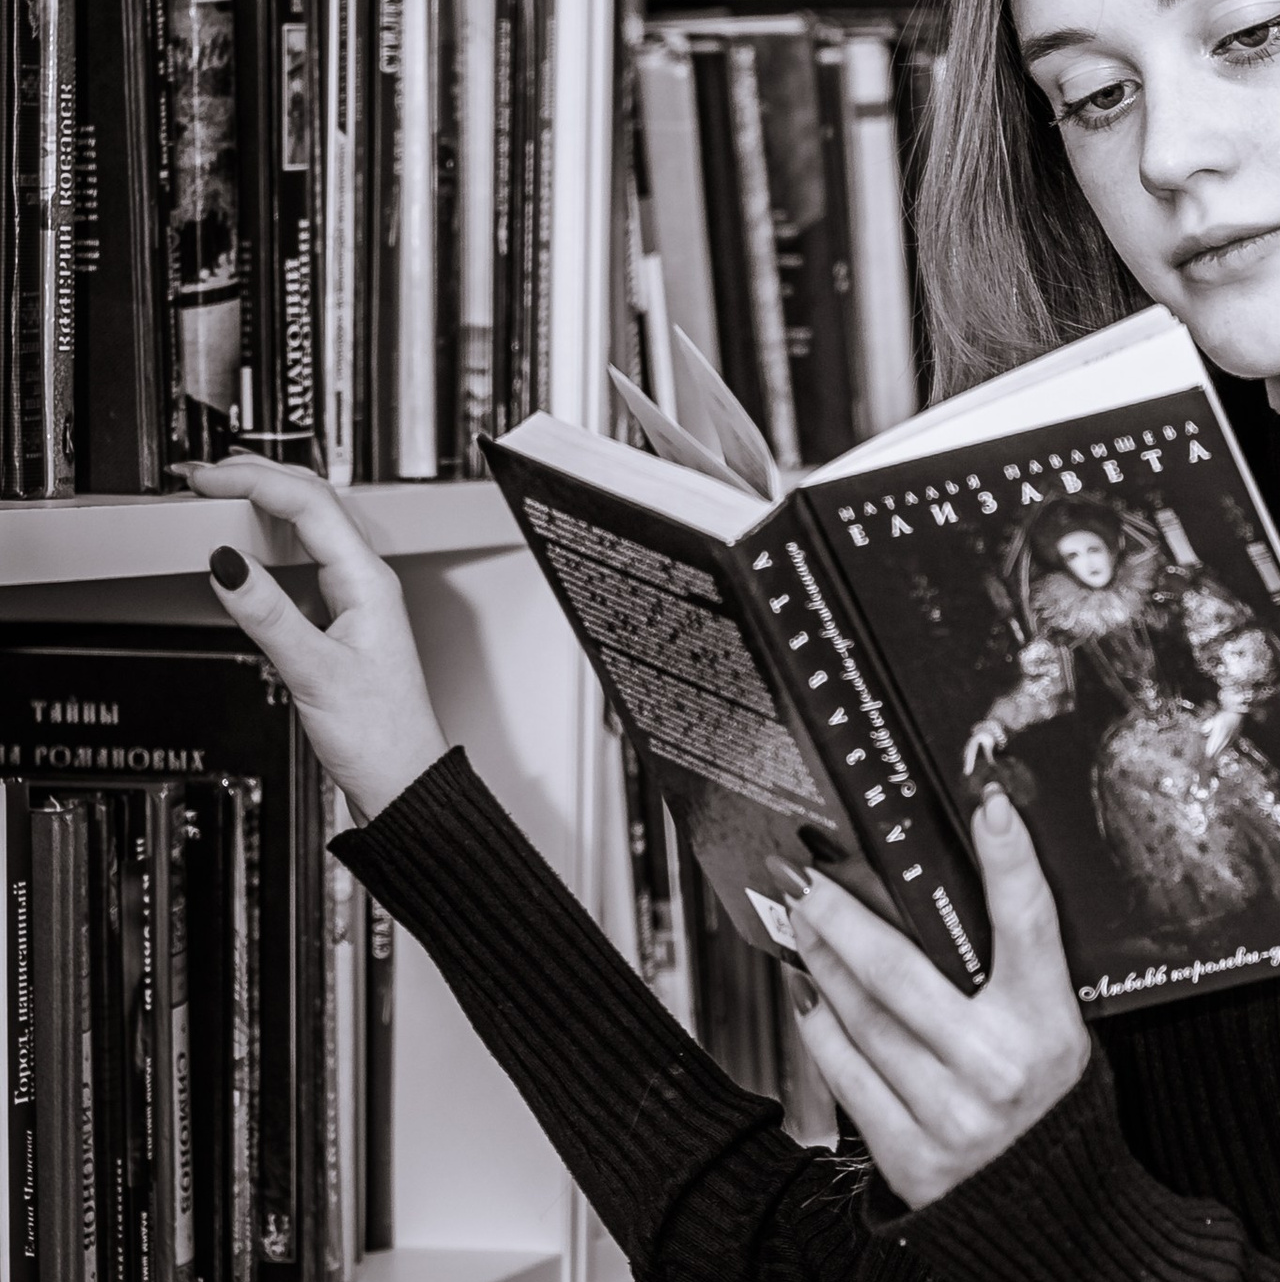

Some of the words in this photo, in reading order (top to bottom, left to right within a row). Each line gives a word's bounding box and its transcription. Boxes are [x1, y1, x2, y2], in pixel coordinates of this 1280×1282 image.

[285, 258, 304, 426] АНАТОЛИЙ
[838, 474, 982, 523] НАТАЛЬЯ
[847, 439, 1212, 547] ЕЛИЗАВЕТА
[30, 695, 119, 725] ТАЙНЫ
[752, 551, 923, 882] ЕЛИЗАВЕТА
[35, 745, 205, 772] РОМАНОВЫХ
[13, 880, 29, 1022] написанный
[1078, 964, 1167, 1002] Любовь
[14, 1028, 31, 1106] Город,
[23, 1130, 34, 1201] Чижова
[82, 1082, 96, 1252] СИМОНОВ
[176, 1051, 193, 1215] СИМОНОВ
[24, 1206, 36, 1258] Елена
